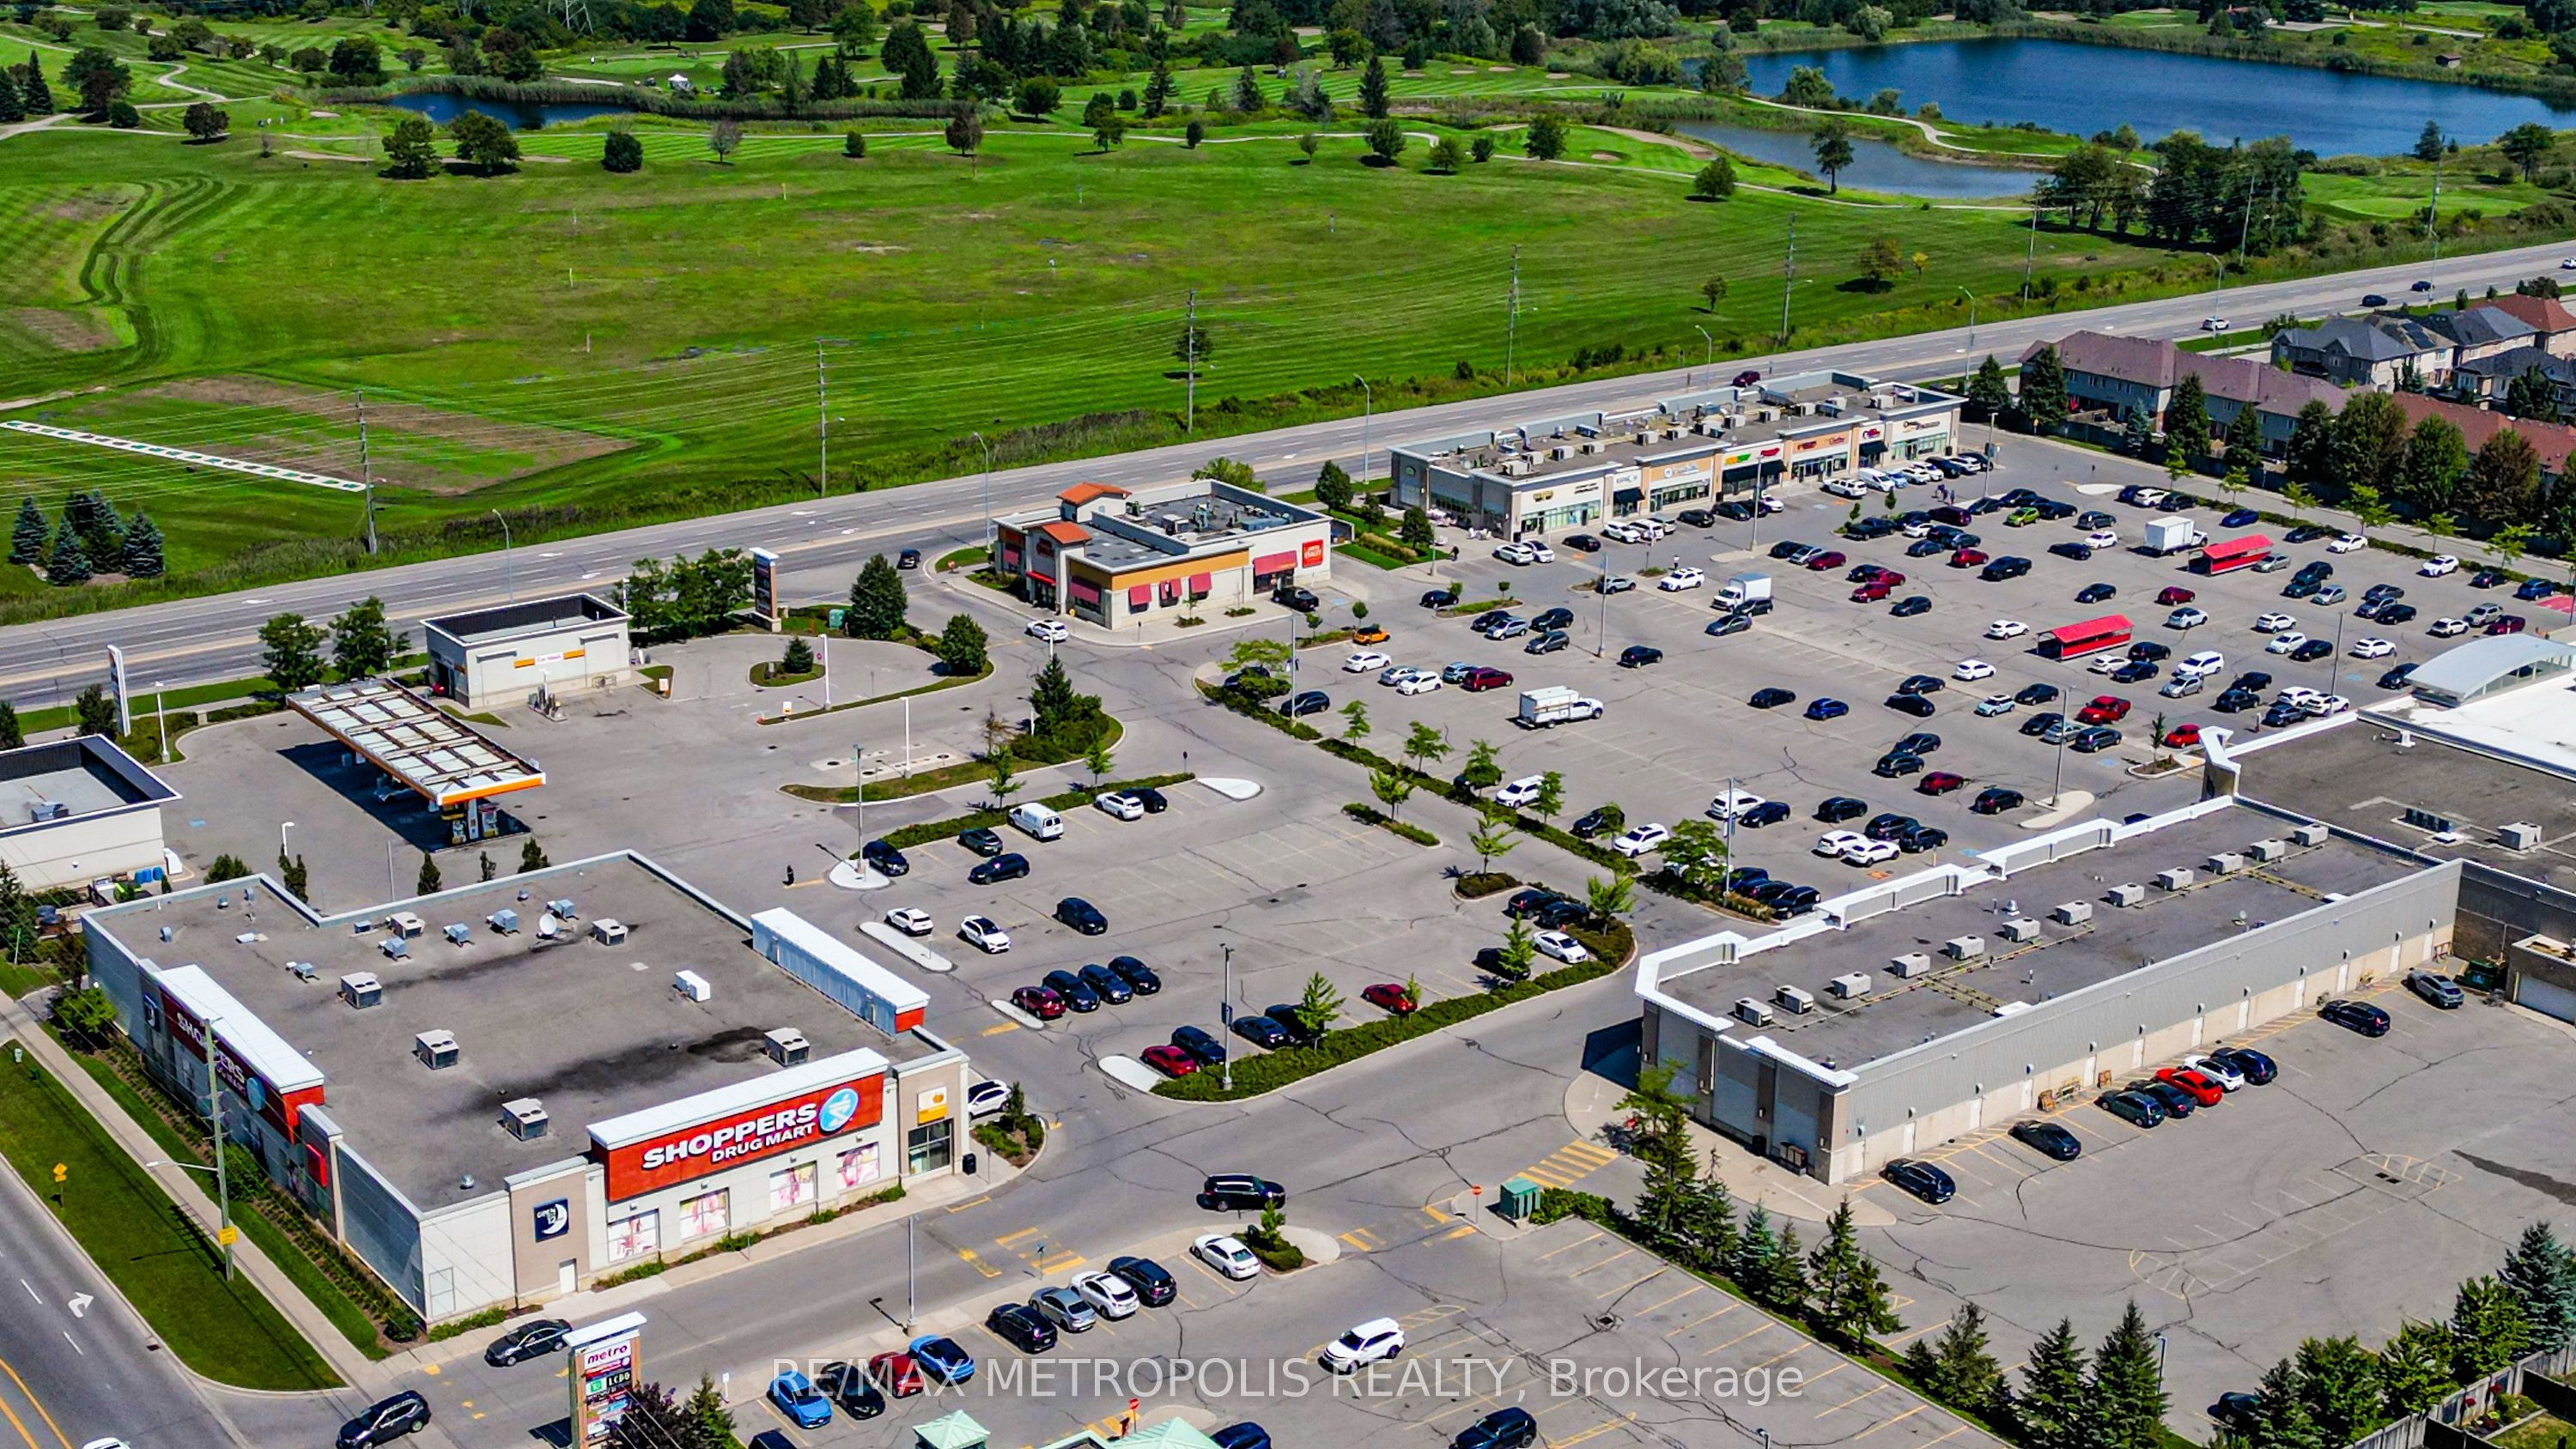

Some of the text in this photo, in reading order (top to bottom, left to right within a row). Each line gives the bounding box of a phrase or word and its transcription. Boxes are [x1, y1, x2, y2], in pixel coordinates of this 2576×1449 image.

[642, 1103, 817, 1169] SHOPPERS
[712, 1122, 816, 1163] DRUG MART
[587, 1345, 628, 1365] metro
[609, 1373, 630, 1386] LCBO
